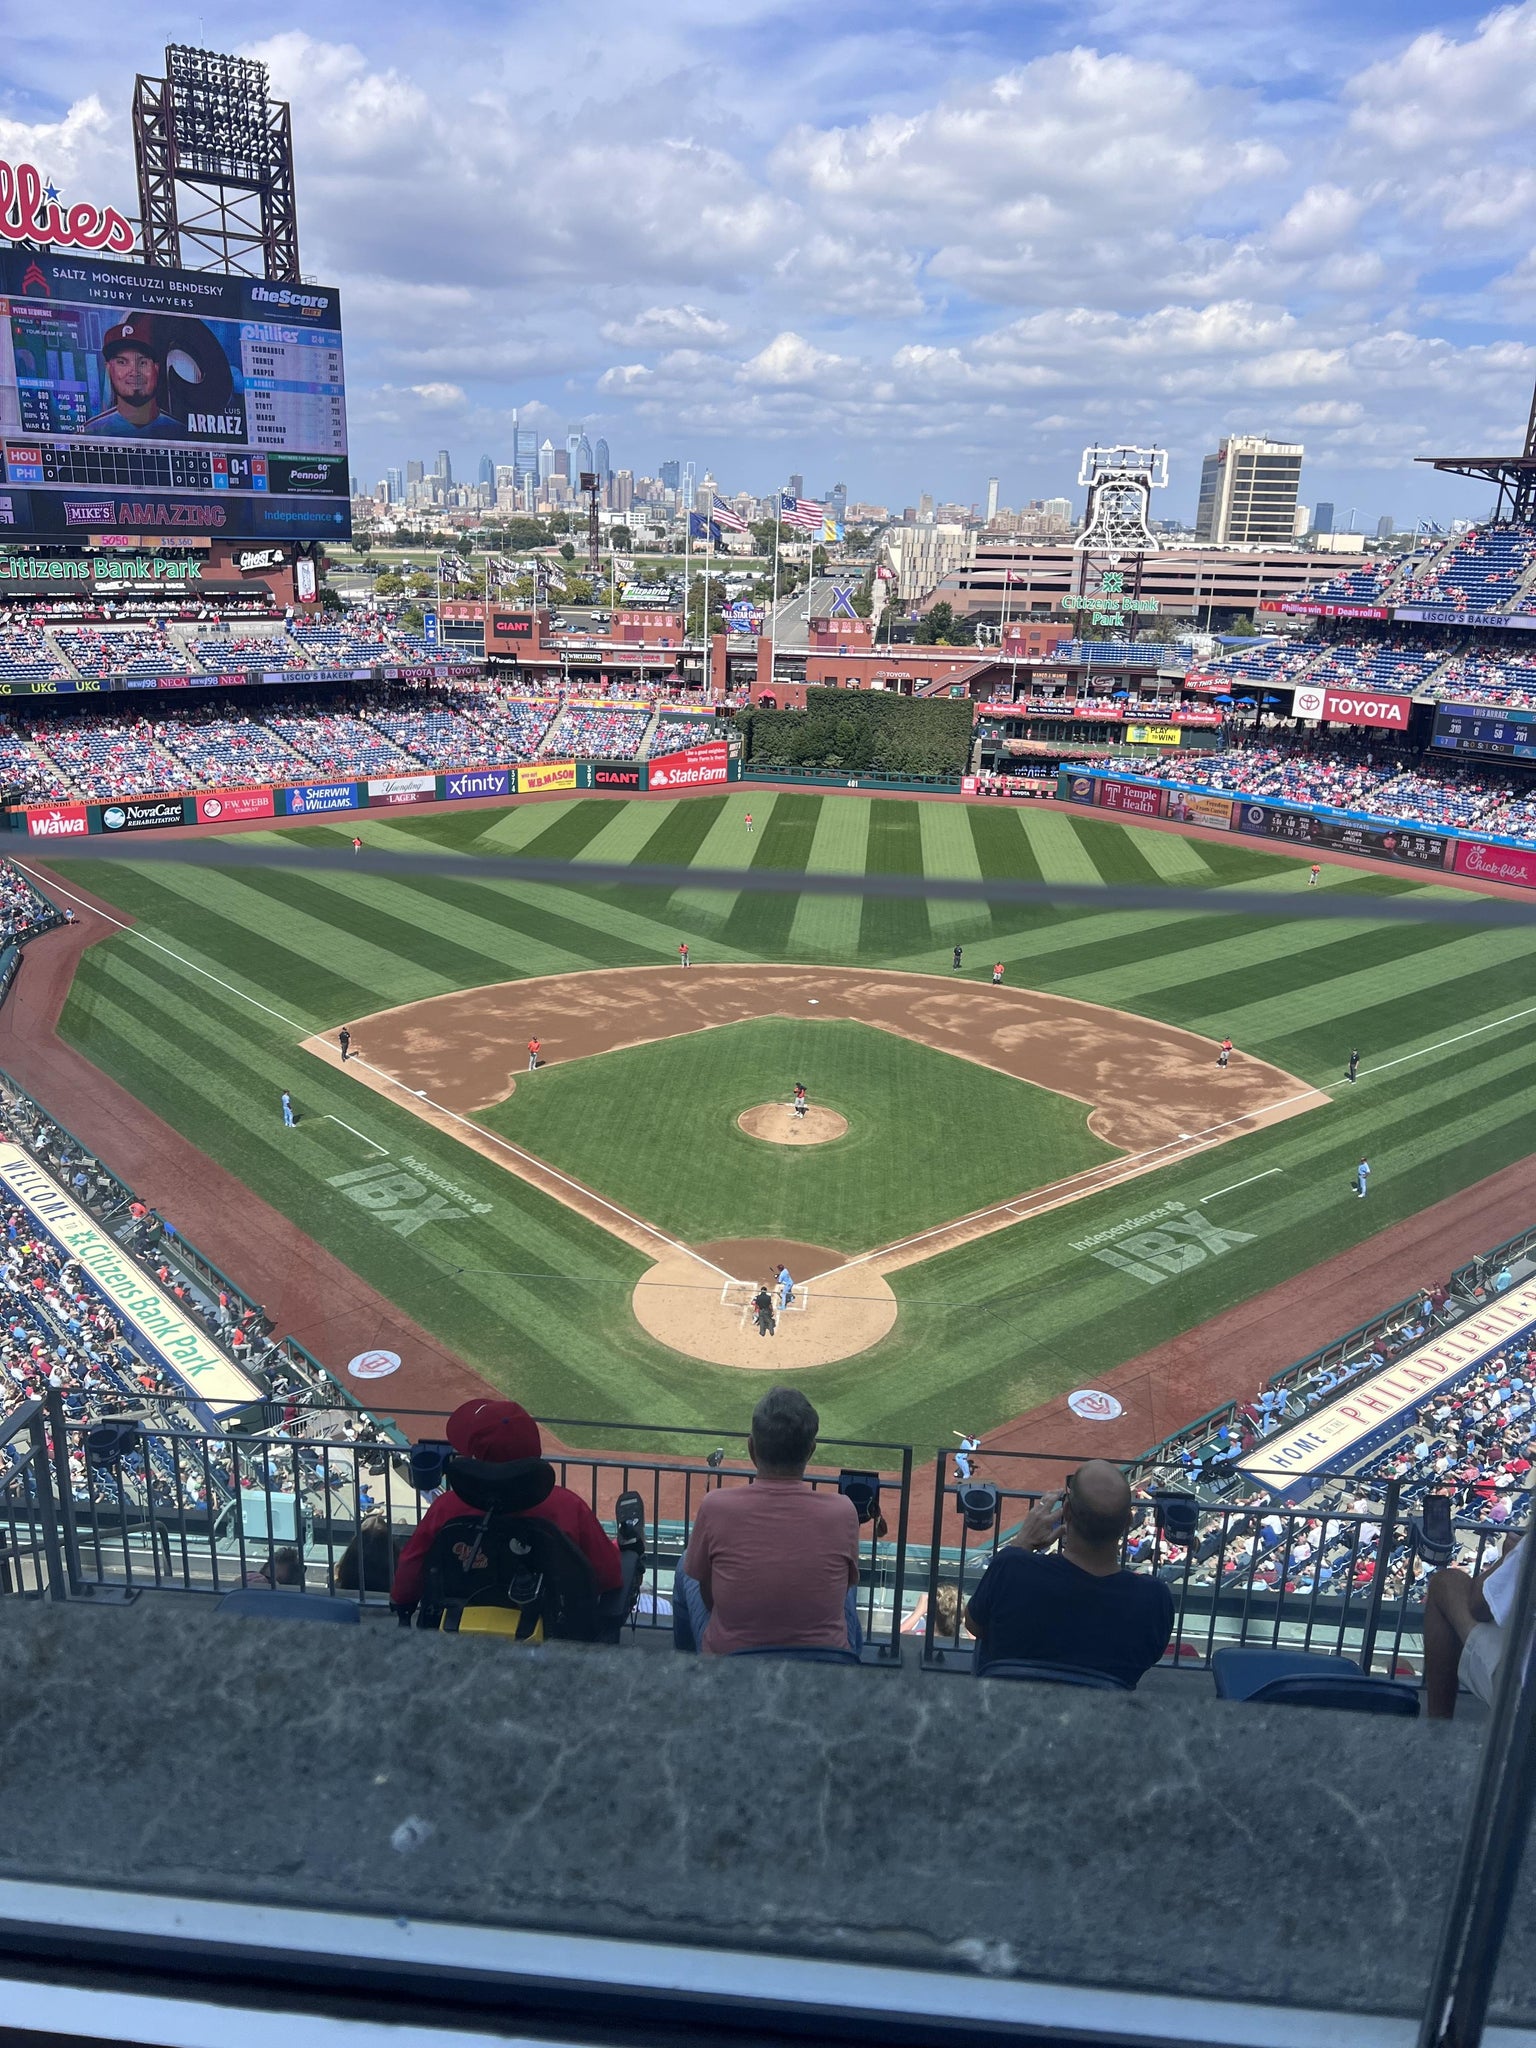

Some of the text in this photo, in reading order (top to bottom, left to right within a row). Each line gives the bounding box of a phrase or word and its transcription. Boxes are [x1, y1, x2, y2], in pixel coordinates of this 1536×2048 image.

[52, 267, 224, 297] SALTZ MONGELUZZI BENDESKY
[89, 288, 194, 308] INJURY LAWYERS
[251, 287, 328, 308] theScore
[256, 414, 276, 422] MARSH
[188, 413, 242, 435] ARRAEZ
[256, 426, 286, 434] CRAWFORD
[11, 451, 36, 462] HOU
[46, 454, 52, 462] 0
[61, 454, 66, 462] 1
[176, 460, 180, 468] 1
[202, 462, 208, 470] 0
[217, 462, 223, 470] 4
[16, 468, 36, 478] PHI
[48, 470, 54, 478] 0
[190, 476, 196, 484] 0
[203, 477, 208, 485] 0
[290, 470, 328, 480] Pennoni
[72, 502, 226, 526] MIKE'S AMAZING
[264, 511, 332, 522] Independence
[102, 535, 128, 546] 5050
[240, 549, 275, 571] GHOST
[0, 556, 202, 579] Citizens Bank Park
[622, 582, 671, 596] Fitzpatrick
[1062, 595, 1158, 612] Citizens Bank
[1282, 604, 1322, 614] Phillies win
[721, 610, 765, 620] ALL STAR GAME
[1338, 608, 1382, 618] Deals roll in
[1092, 612, 1124, 626] Park
[1422, 612, 1510, 626] LISCIO'S BAKERY
[496, 622, 530, 632] GIANT
[400, 668, 432, 677] TOYOTA
[450, 666, 482, 675] TOYOTA
[221, 676, 246, 684] NECA
[282, 671, 354, 682] LISCIO'S BAKERY
[31, 682, 56, 693] UKG
[76, 680, 100, 692] UKG
[160, 678, 187, 687] NECA
[1198, 680, 1212, 688] THIS
[1213, 678, 1230, 686] SIGN
[1328, 698, 1402, 720] TOYOTA
[1472, 708, 1508, 720] LUIS ARRAEZ
[1150, 726, 1170, 734] PLAY
[1158, 734, 1176, 742] WIN!
[596, 772, 638, 783] GIANT
[224, 785, 262, 793] ASPLUNDH
[381, 779, 424, 793] Yuengling
[450, 774, 504, 796] xfinity
[846, 780, 858, 788] 401
[129, 793, 170, 801] ASPLUNDH
[178, 788, 217, 797] ASPLUNDH
[306, 788, 350, 800] SHERWIN
[1124, 786, 1157, 801] Temple
[80, 798, 121, 806] ASPLUNDH
[242, 797, 269, 807] WEBB
[390, 794, 416, 803] LAGER
[1206, 800, 1229, 808] Freedom
[27, 802, 72, 810] ASPLUNDH
[1122, 798, 1154, 813] Health
[1284, 801, 1309, 809] Independence
[126, 804, 182, 819] NovaCare
[1211, 808, 1228, 816] Cancer
[128, 816, 181, 827] REHABILITATION
[1367, 815, 1394, 824] Independence
[32, 819, 84, 836] Wawa
[1458, 830, 1488, 840] Independence
[1466, 846, 1528, 880] Chick-fil-A
[399, 1156, 478, 1205] Independence
[325, 1162, 470, 1238] IBX
[1068, 1206, 1171, 1252] Independence
[1091, 1210, 1258, 1284] IBX
[1, 1160, 222, 1377] WELCOME Citizens Bank Park
[1269, 1303, 1529, 1468] HOME PHILADELPHIA
